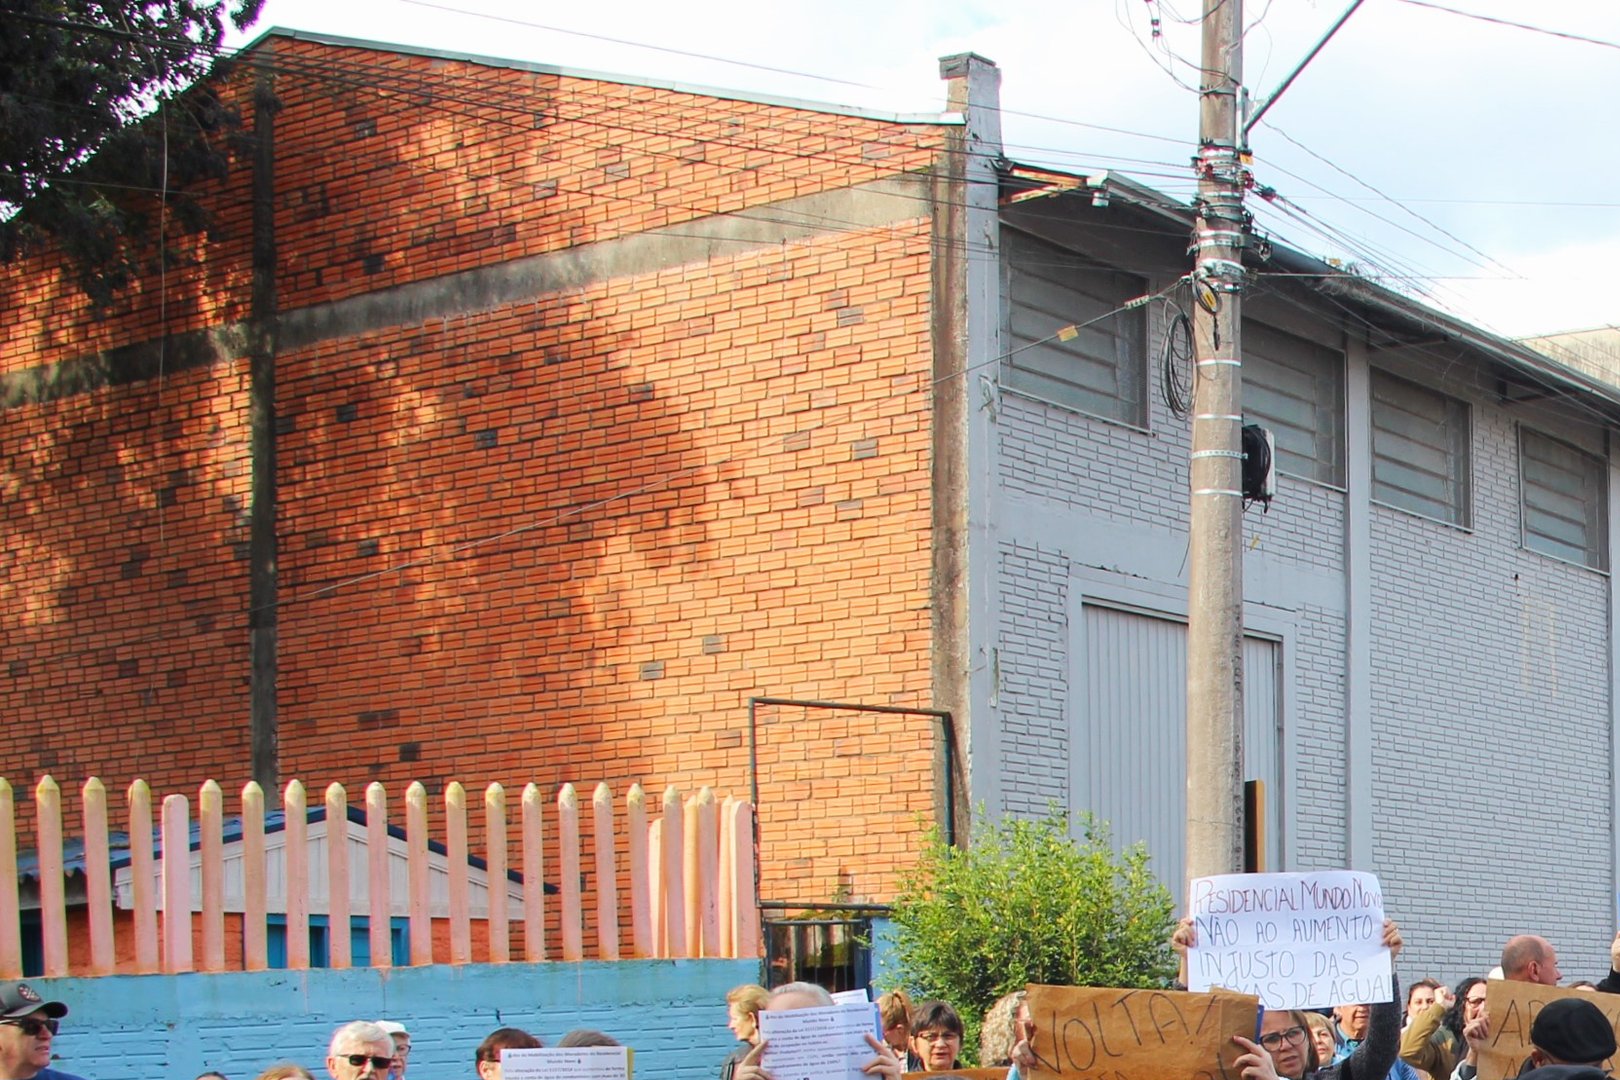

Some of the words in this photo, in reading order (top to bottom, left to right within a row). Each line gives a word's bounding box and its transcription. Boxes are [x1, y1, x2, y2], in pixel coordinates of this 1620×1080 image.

[1195, 915, 1239, 947] NÃO
[1256, 921, 1278, 944] AO
[1293, 914, 1373, 943] AUMENTO
[1314, 951, 1359, 979] DAS
[1292, 982, 1318, 1009] DE
